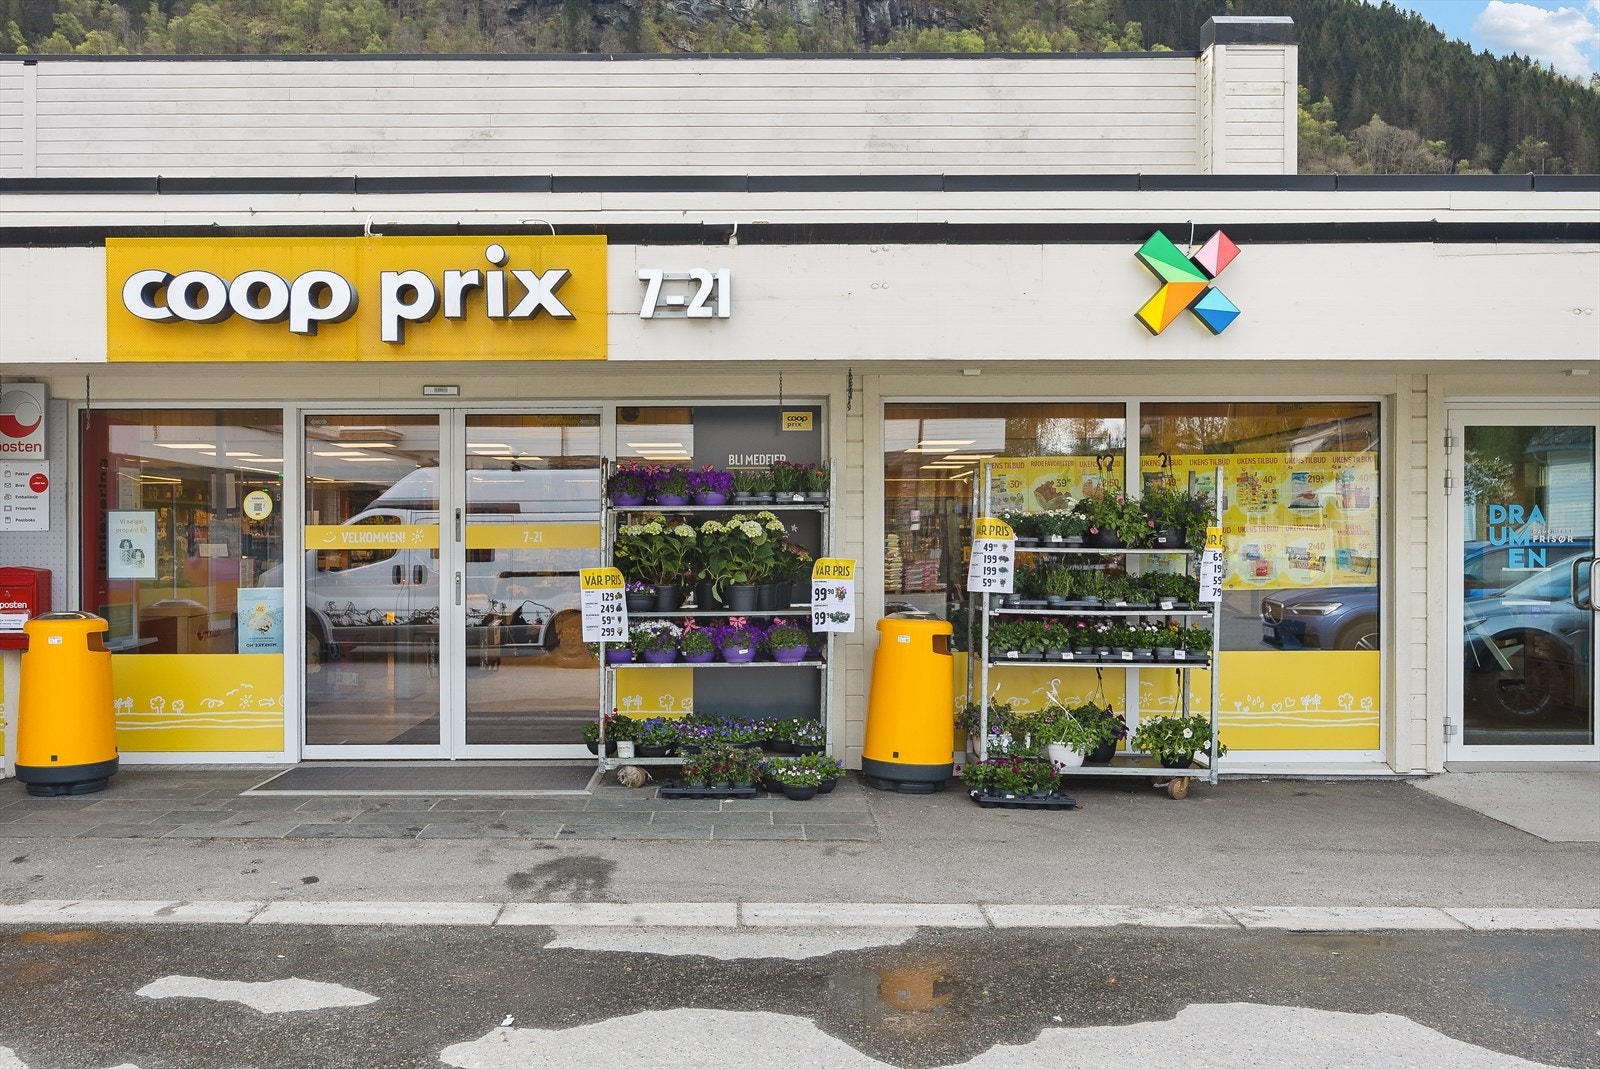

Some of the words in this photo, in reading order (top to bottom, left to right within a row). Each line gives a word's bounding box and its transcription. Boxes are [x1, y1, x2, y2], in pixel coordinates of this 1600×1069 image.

[122, 269, 358, 335] coop
[380, 244, 575, 343] prix
[638, 268, 731, 318] 7-21
[0, 441, 42, 452] osten
[728, 454, 743, 465] BLI
[1305, 456, 1326, 464] TILBUD
[1489, 504, 1547, 525] DRA
[126, 518, 145, 526] selger
[988, 525, 1010, 537] PRIS
[1257, 525, 1279, 533] TILBUD
[341, 531, 406, 543] VELKOMMEN!
[523, 531, 543, 542] 7-21
[1489, 526, 1531, 547] UM
[1532, 535, 1574, 543] FRISØR
[983, 543, 994, 552] 49
[983, 555, 998, 564] 199
[1508, 548, 1547, 569] EN
[815, 562, 831, 576] VÅR
[832, 565, 850, 577] PRIS
[983, 566, 997, 575] 199
[584, 572, 603, 586] VÅR
[604, 574, 622, 586] PRIS
[982, 578, 992, 587] 59
[601, 592, 614, 602] 129
[1212, 588, 1222, 597] 79
[600, 604, 615, 613] 249
[601, 616, 612, 625] 59
[601, 627, 615, 637] 299
